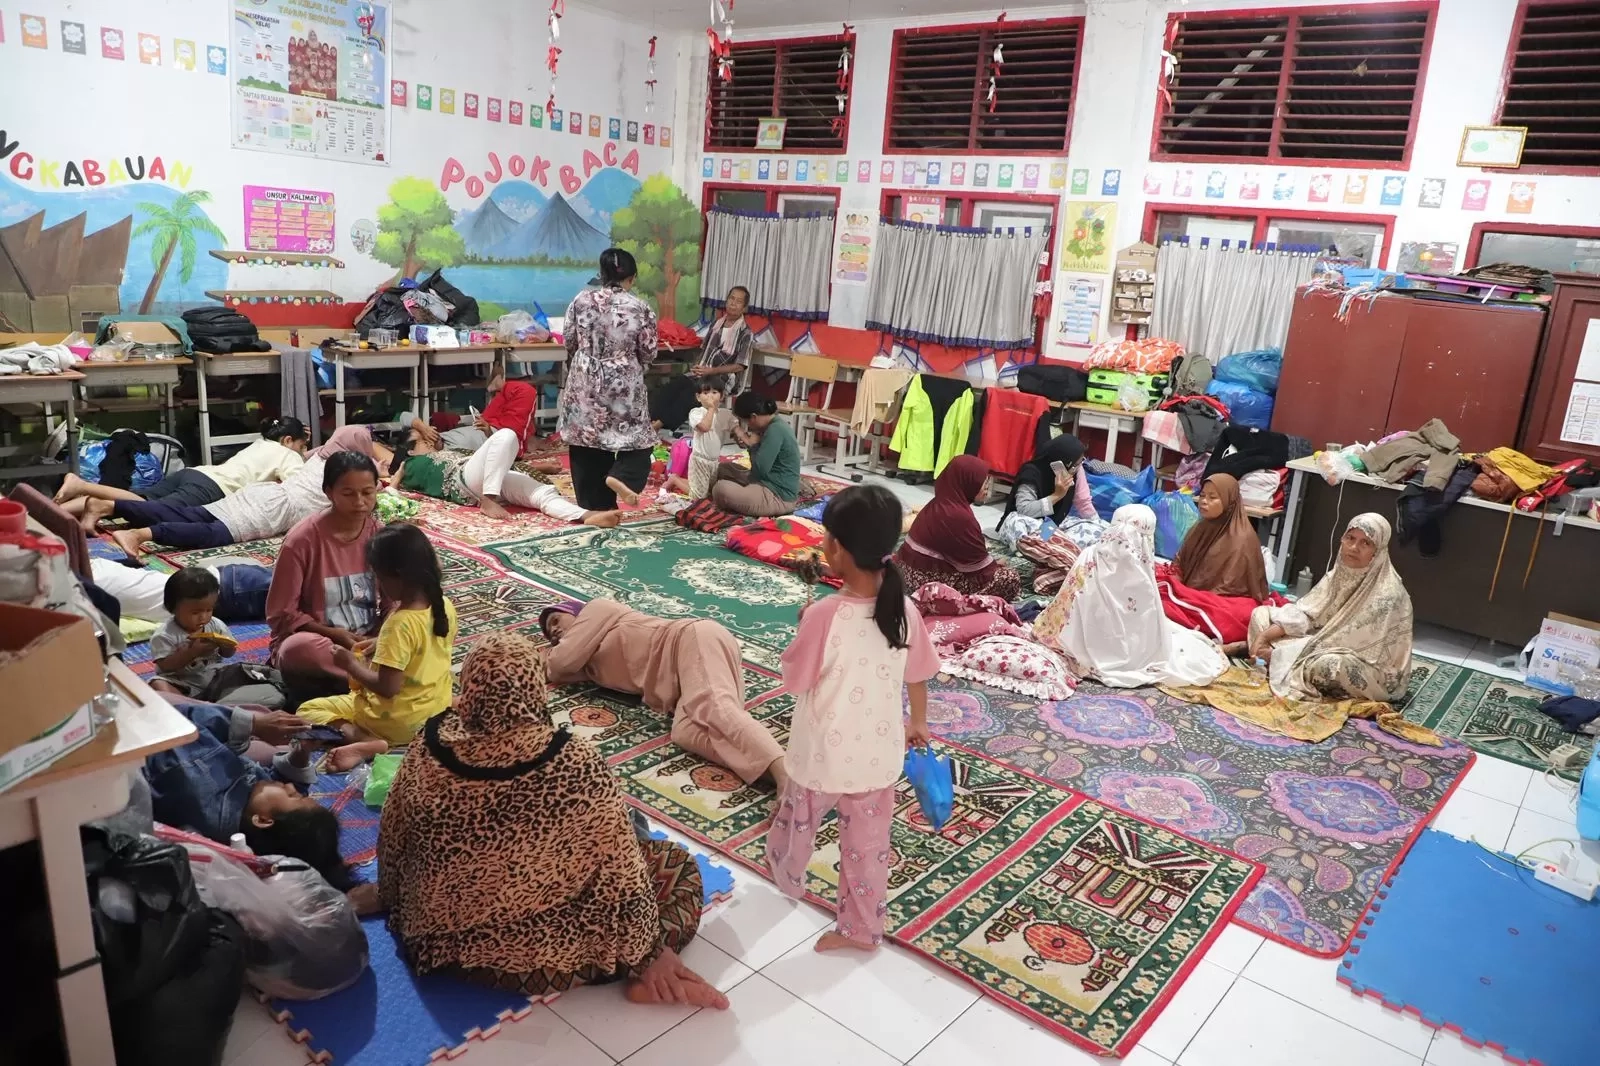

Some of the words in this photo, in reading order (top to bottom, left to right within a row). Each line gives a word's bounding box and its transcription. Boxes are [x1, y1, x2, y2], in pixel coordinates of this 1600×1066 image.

[440, 151, 551, 198] POJOK
[559, 142, 640, 194] BACA
[266, 191, 287, 200] UNSUR
[290, 193, 318, 202] KALIMAT
